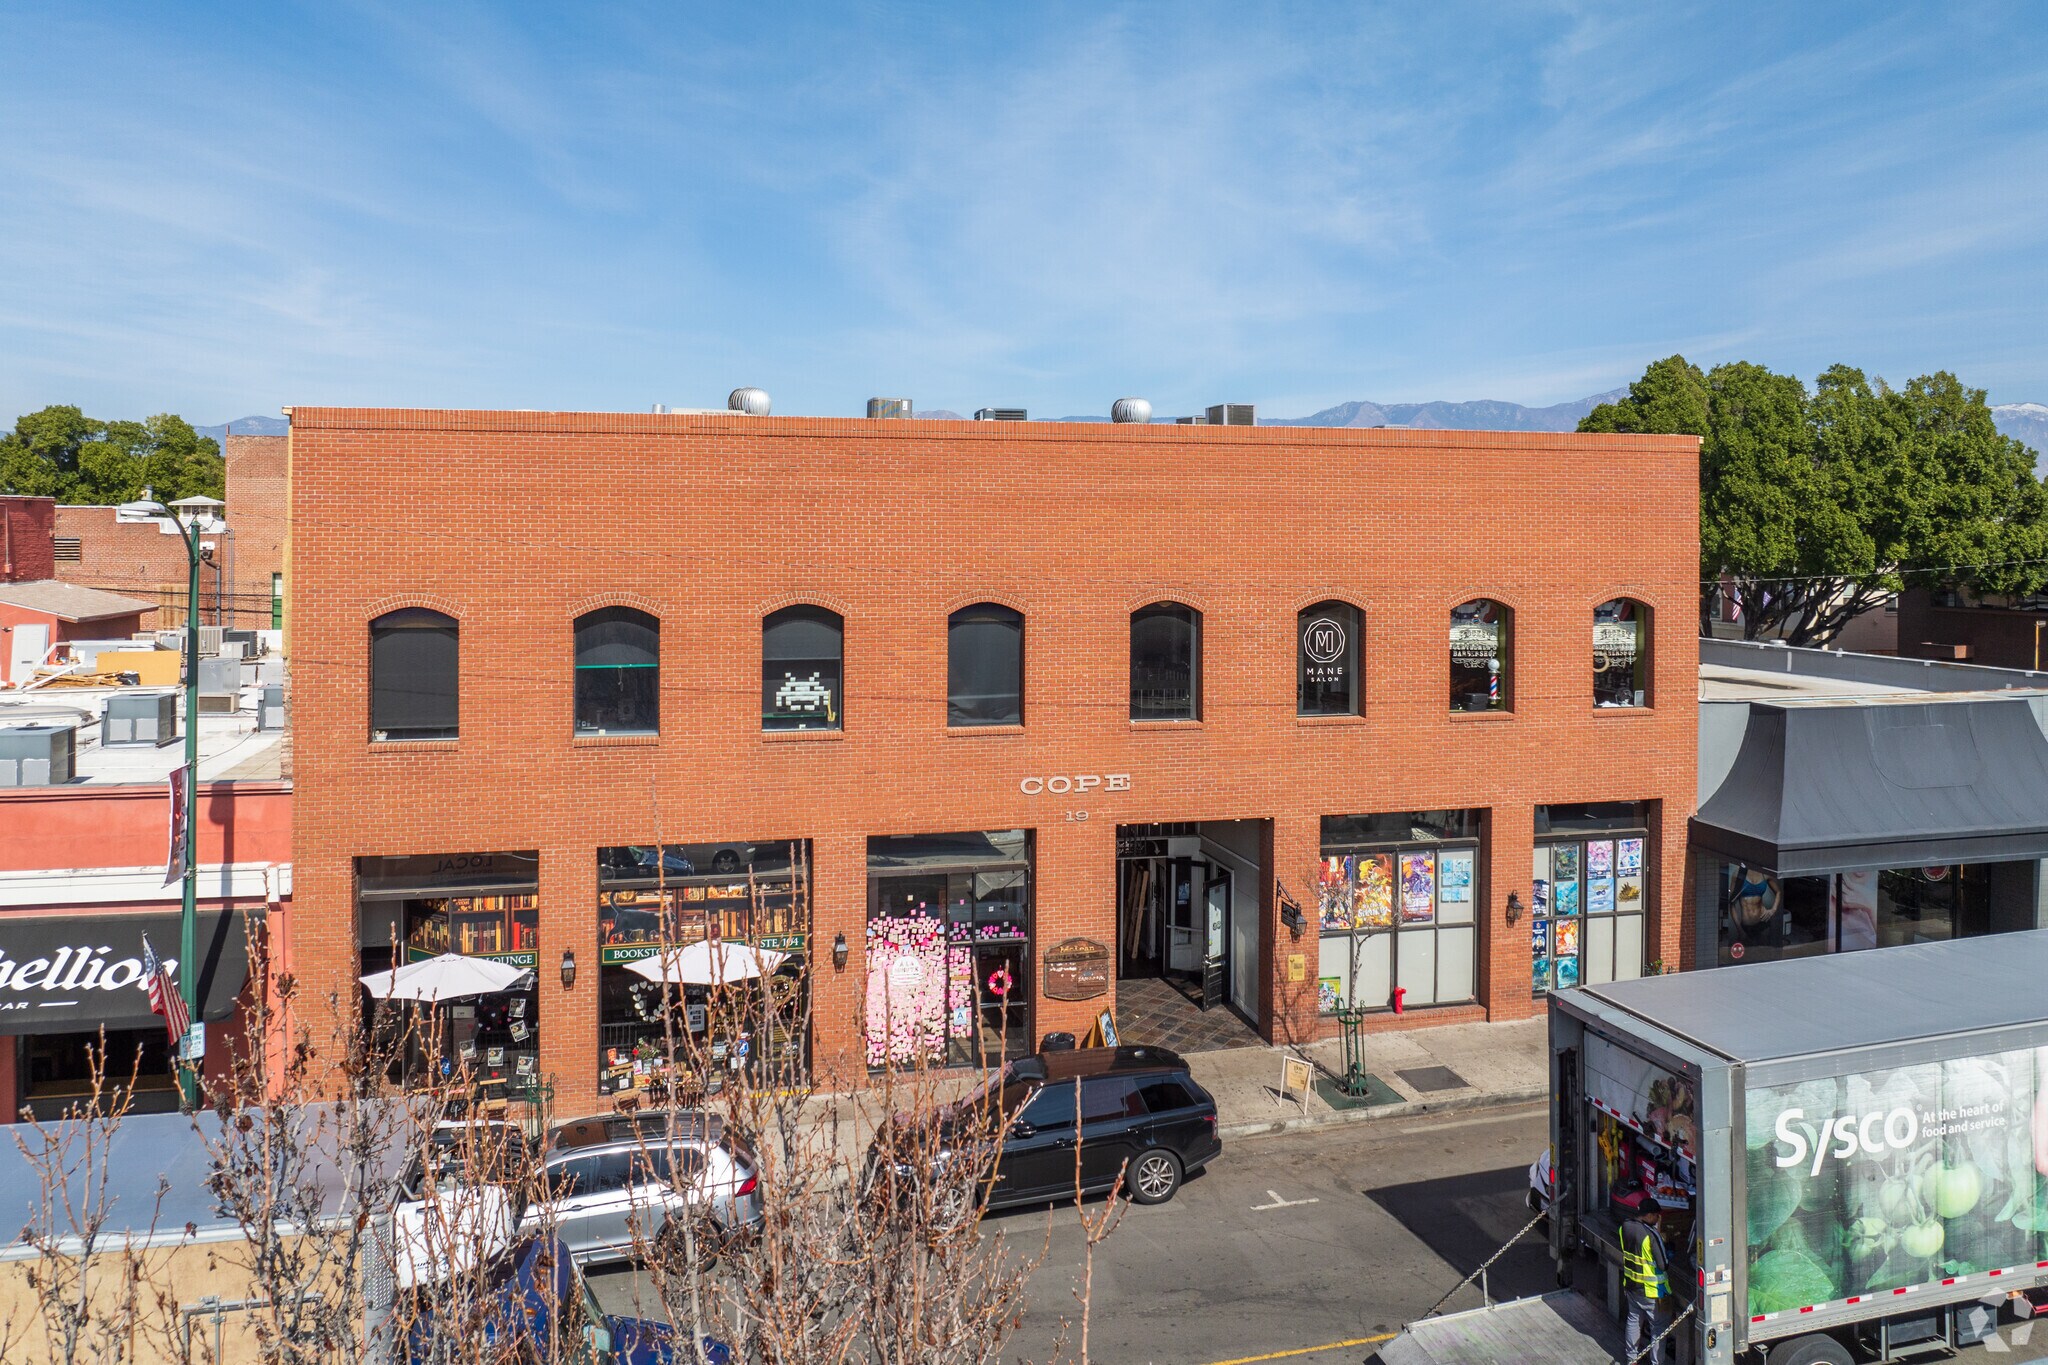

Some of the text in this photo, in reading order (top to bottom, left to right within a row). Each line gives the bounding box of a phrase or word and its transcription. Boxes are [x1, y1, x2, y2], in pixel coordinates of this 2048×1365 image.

[1307, 667, 1343, 675] MANE
[1020, 773, 1131, 795] COPE
[1066, 811, 1089, 822] 19
[613, 947, 668, 960] BOOKSTO
[0, 1002, 29, 1010] AR
[1922, 1102, 2005, 1124] At the heart of
[1922, 1115, 2005, 1138] food and service
